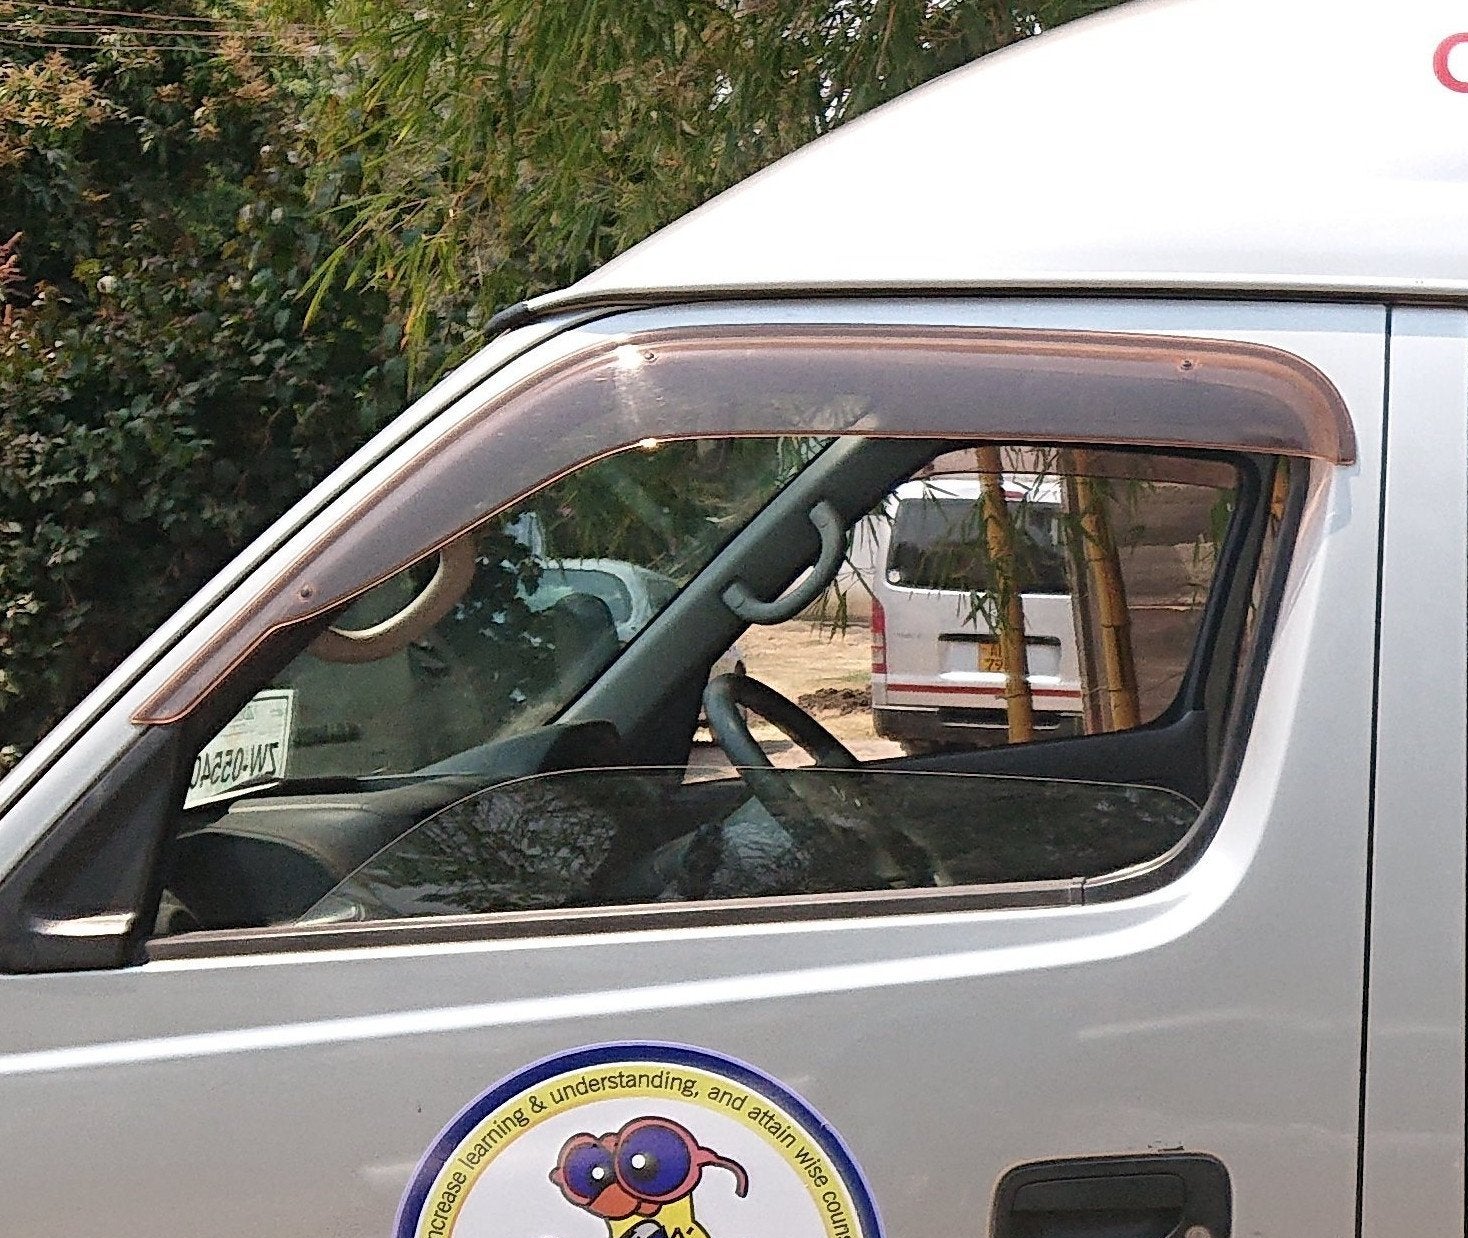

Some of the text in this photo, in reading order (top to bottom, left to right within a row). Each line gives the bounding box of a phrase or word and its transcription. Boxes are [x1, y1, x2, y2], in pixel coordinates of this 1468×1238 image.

[458, 1107, 530, 1171] learning
[527, 1094, 548, 1114] &
[549, 1071, 700, 1105] understanding,
[707, 1085, 748, 1111] and
[747, 1106, 797, 1149] attain
[795, 1146, 829, 1188] wise
